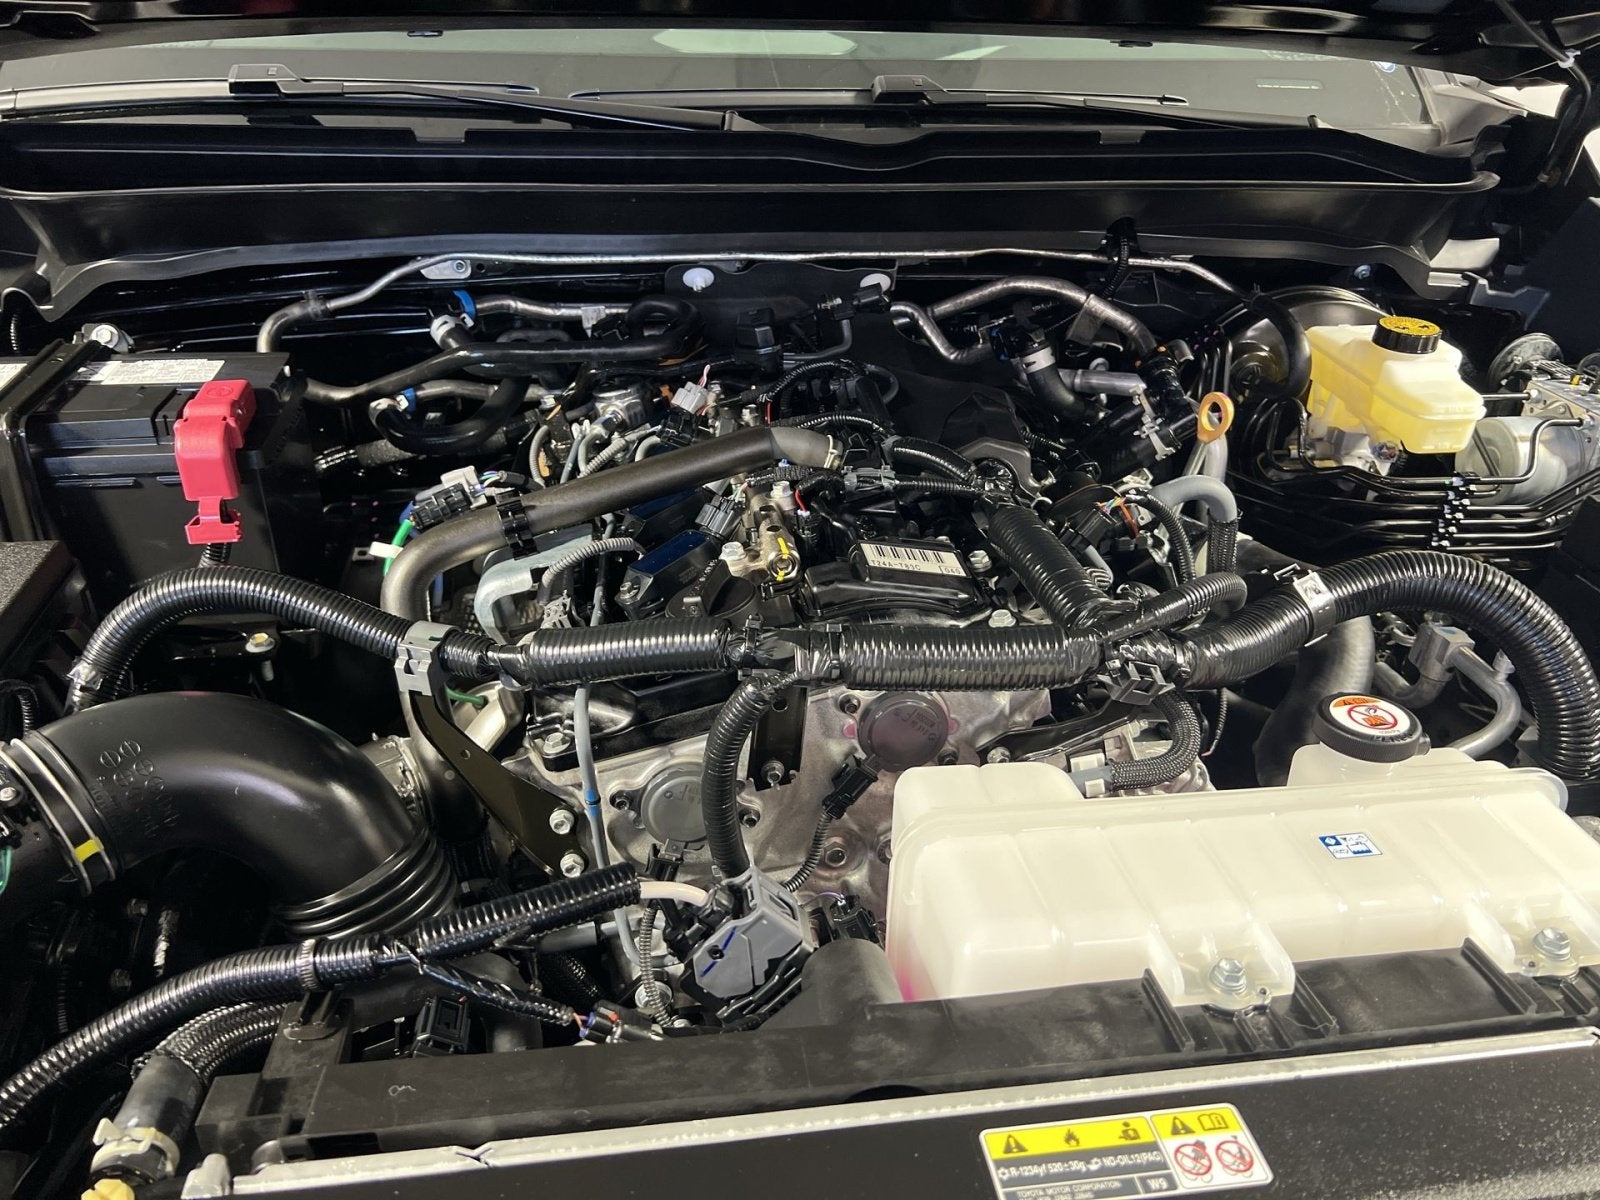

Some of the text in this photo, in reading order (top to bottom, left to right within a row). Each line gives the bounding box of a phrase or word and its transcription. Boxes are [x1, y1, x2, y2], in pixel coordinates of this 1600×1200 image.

[1009, 1164, 1047, 1177] R-1234yf
[1102, 1151, 1164, 1168] ND-OIL12(PAG)
[1017, 1189, 1044, 1198] TOYOTA
[1045, 1185, 1071, 1194] MOTOR
[1072, 1180, 1121, 1192] CORPORATION
[1147, 1178, 1168, 1191] W9
